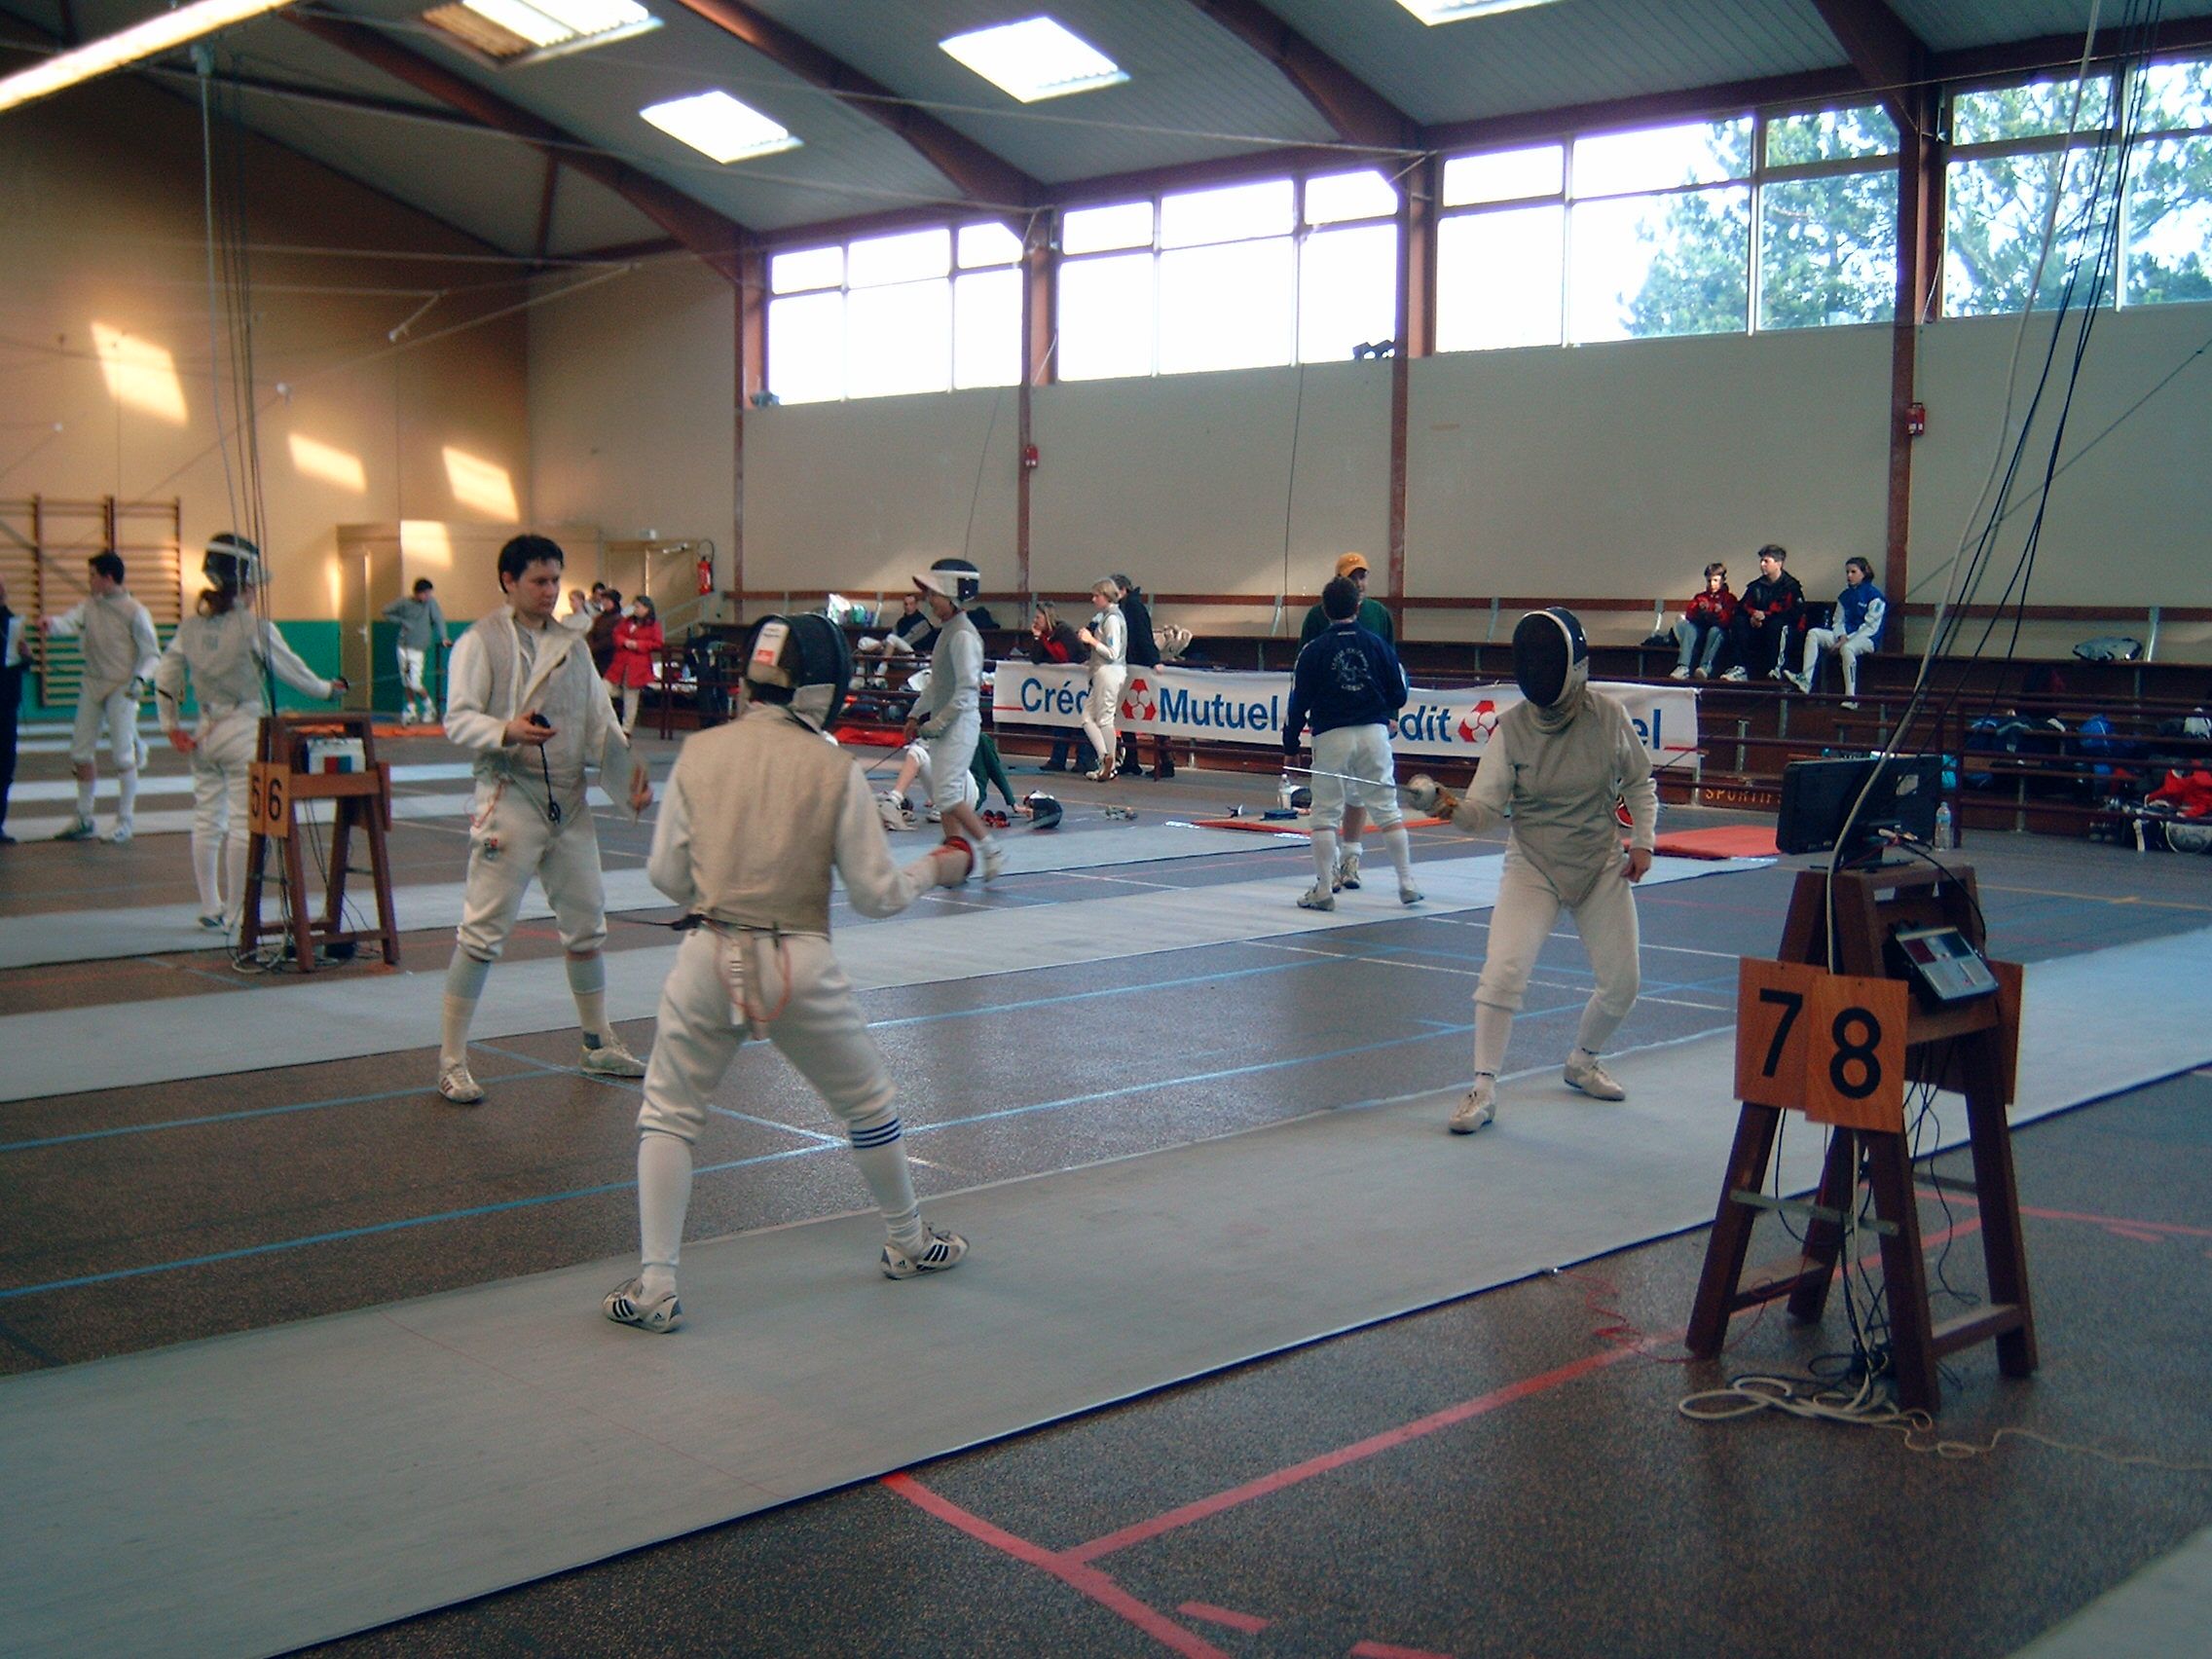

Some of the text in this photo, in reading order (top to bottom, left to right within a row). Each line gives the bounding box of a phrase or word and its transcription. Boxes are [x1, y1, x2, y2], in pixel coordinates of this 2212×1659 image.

[1160, 687, 1278, 732] Mutuel
[269, 778, 282, 821] 6
[1759, 988, 1803, 1078] 7
[1829, 1007, 1881, 1099] 8
